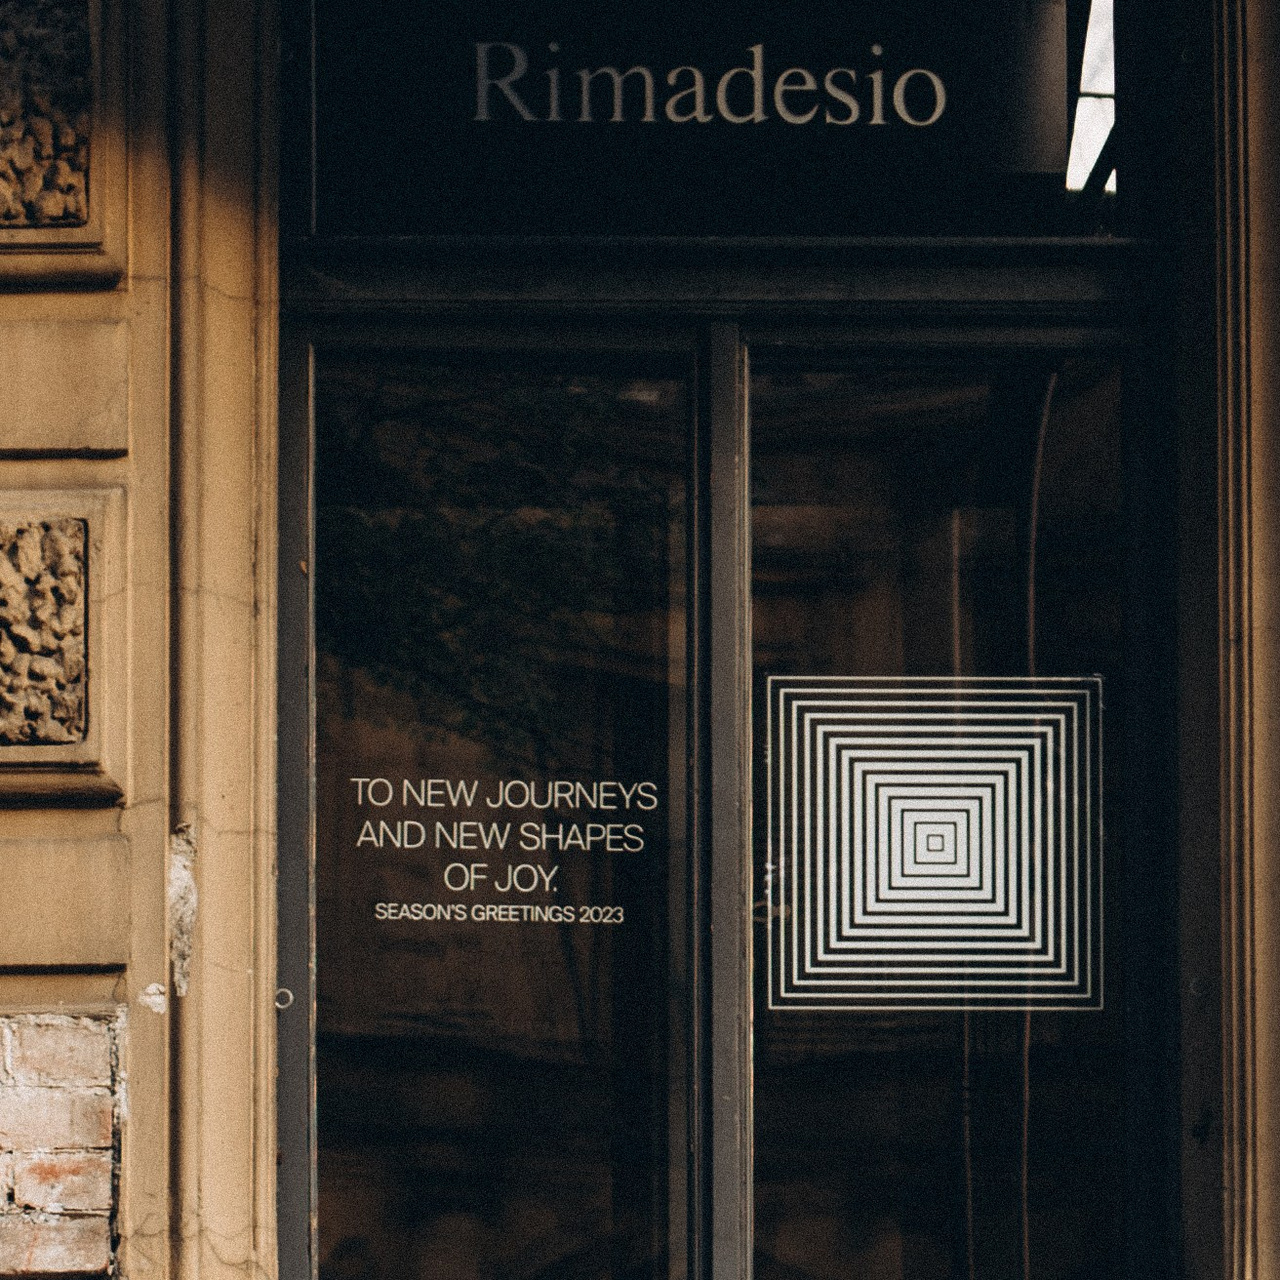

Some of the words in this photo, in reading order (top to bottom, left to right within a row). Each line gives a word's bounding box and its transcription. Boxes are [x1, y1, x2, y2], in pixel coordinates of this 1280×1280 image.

[473, 40, 948, 127] Rimadesio
[350, 777, 394, 808] TO
[403, 778, 479, 808] NEW
[486, 780, 658, 811] JOURNEYS
[356, 820, 426, 849] AND
[435, 821, 511, 851] NEW
[519, 822, 645, 852] SHAPES
[443, 862, 489, 892] OF
[494, 863, 559, 893] JOY.
[375, 903, 467, 921] SEASON'S
[471, 904, 576, 923] GREETINGS
[579, 905, 625, 923] 2023
